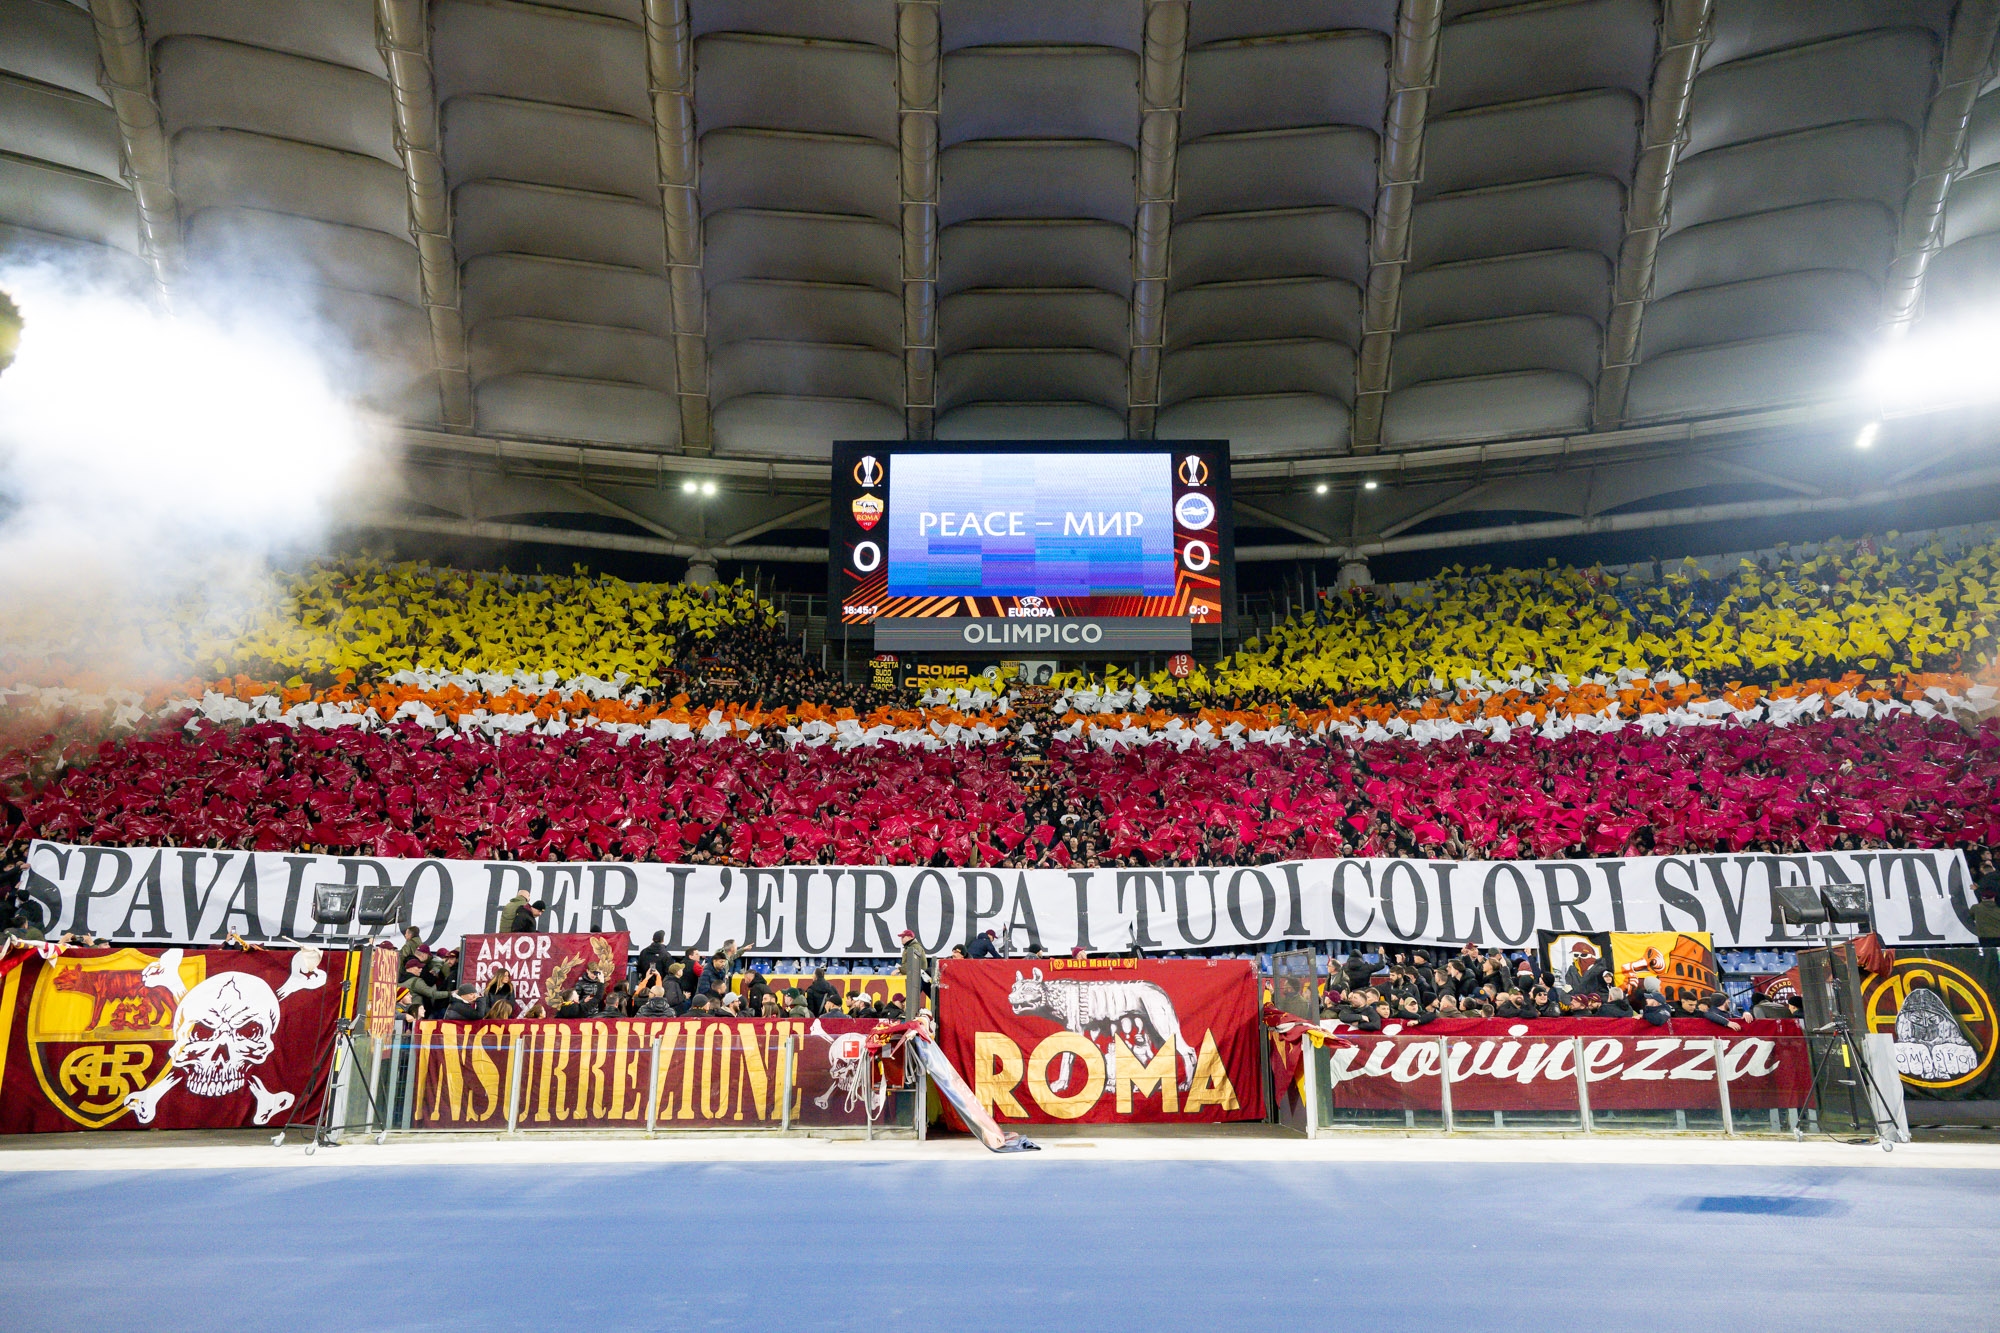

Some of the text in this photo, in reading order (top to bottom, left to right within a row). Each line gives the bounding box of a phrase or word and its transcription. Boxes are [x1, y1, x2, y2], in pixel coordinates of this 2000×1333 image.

[919, 512, 1026, 536] PEACE
[1064, 511, 1144, 536] МИР
[853, 541, 881, 572] 0
[1183, 540, 1211, 571] 0
[1020, 597, 1043, 606] UEFA
[1008, 607, 1056, 618] EUROPA
[963, 623, 1103, 644] OLIMPICO
[917, 664, 969, 675] ROMA
[1174, 655, 1187, 664] 19
[1175, 664, 1189, 675] AS
[26, 844, 453, 948] SPAVALDO
[484, 864, 639, 950] PER
[1068, 872, 1098, 951] I
[1116, 862, 1311, 947] TUOI
[1331, 860, 1628, 945] COLORI
[477, 935, 551, 962] AMOR
[475, 960, 542, 981] ROMAE
[1067, 958, 1121, 969] Daje Mauro!
[475, 980, 541, 999] NTRA
[1896, 1053, 1933, 1065] OMA
[414, 1020, 805, 1122] INSURREZIONE
[974, 1028, 1240, 1120] ROMA
